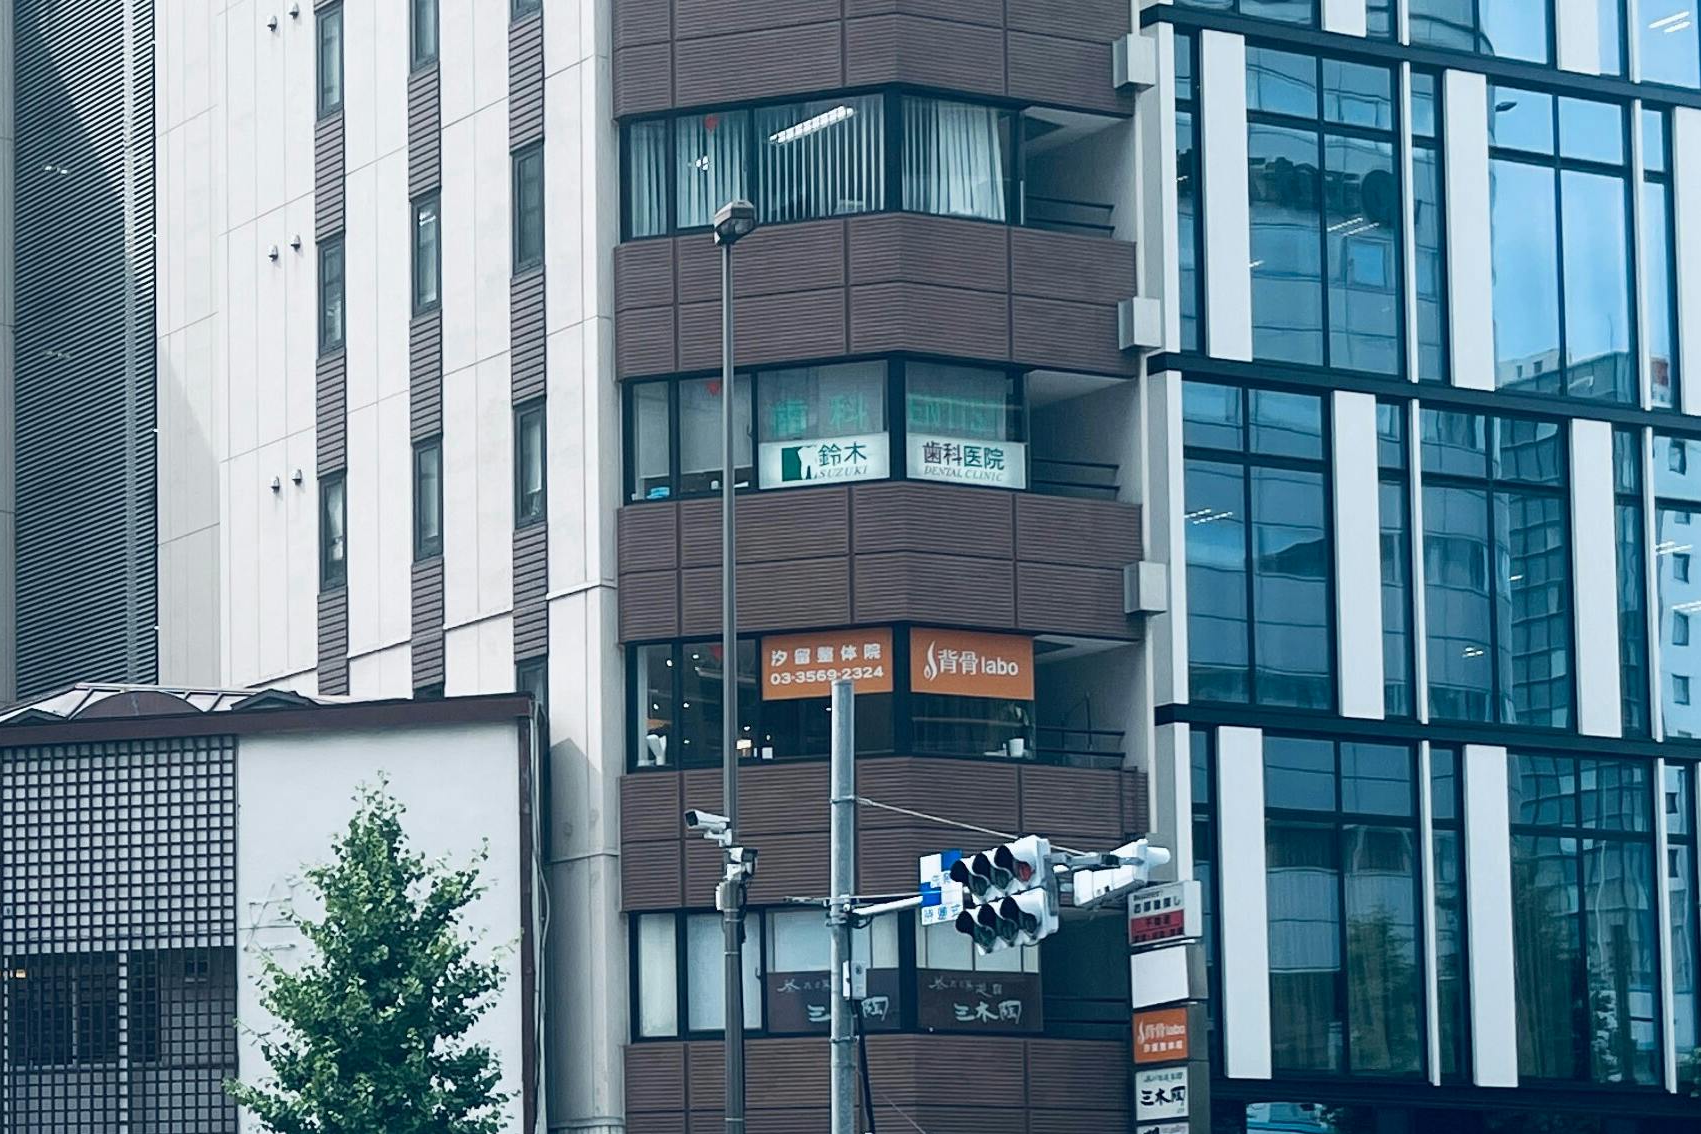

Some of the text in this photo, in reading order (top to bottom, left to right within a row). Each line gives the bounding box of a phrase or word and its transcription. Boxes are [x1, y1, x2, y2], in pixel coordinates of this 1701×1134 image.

[817, 441, 867, 467] 鈴木
[922, 440, 1005, 471] 歯科医院
[818, 465, 868, 479] SUZUKI
[923, 465, 1003, 483] DENTAL CLINIC
[771, 643, 881, 667] 汐留整体院
[937, 649, 1019, 677] 背骨labo
